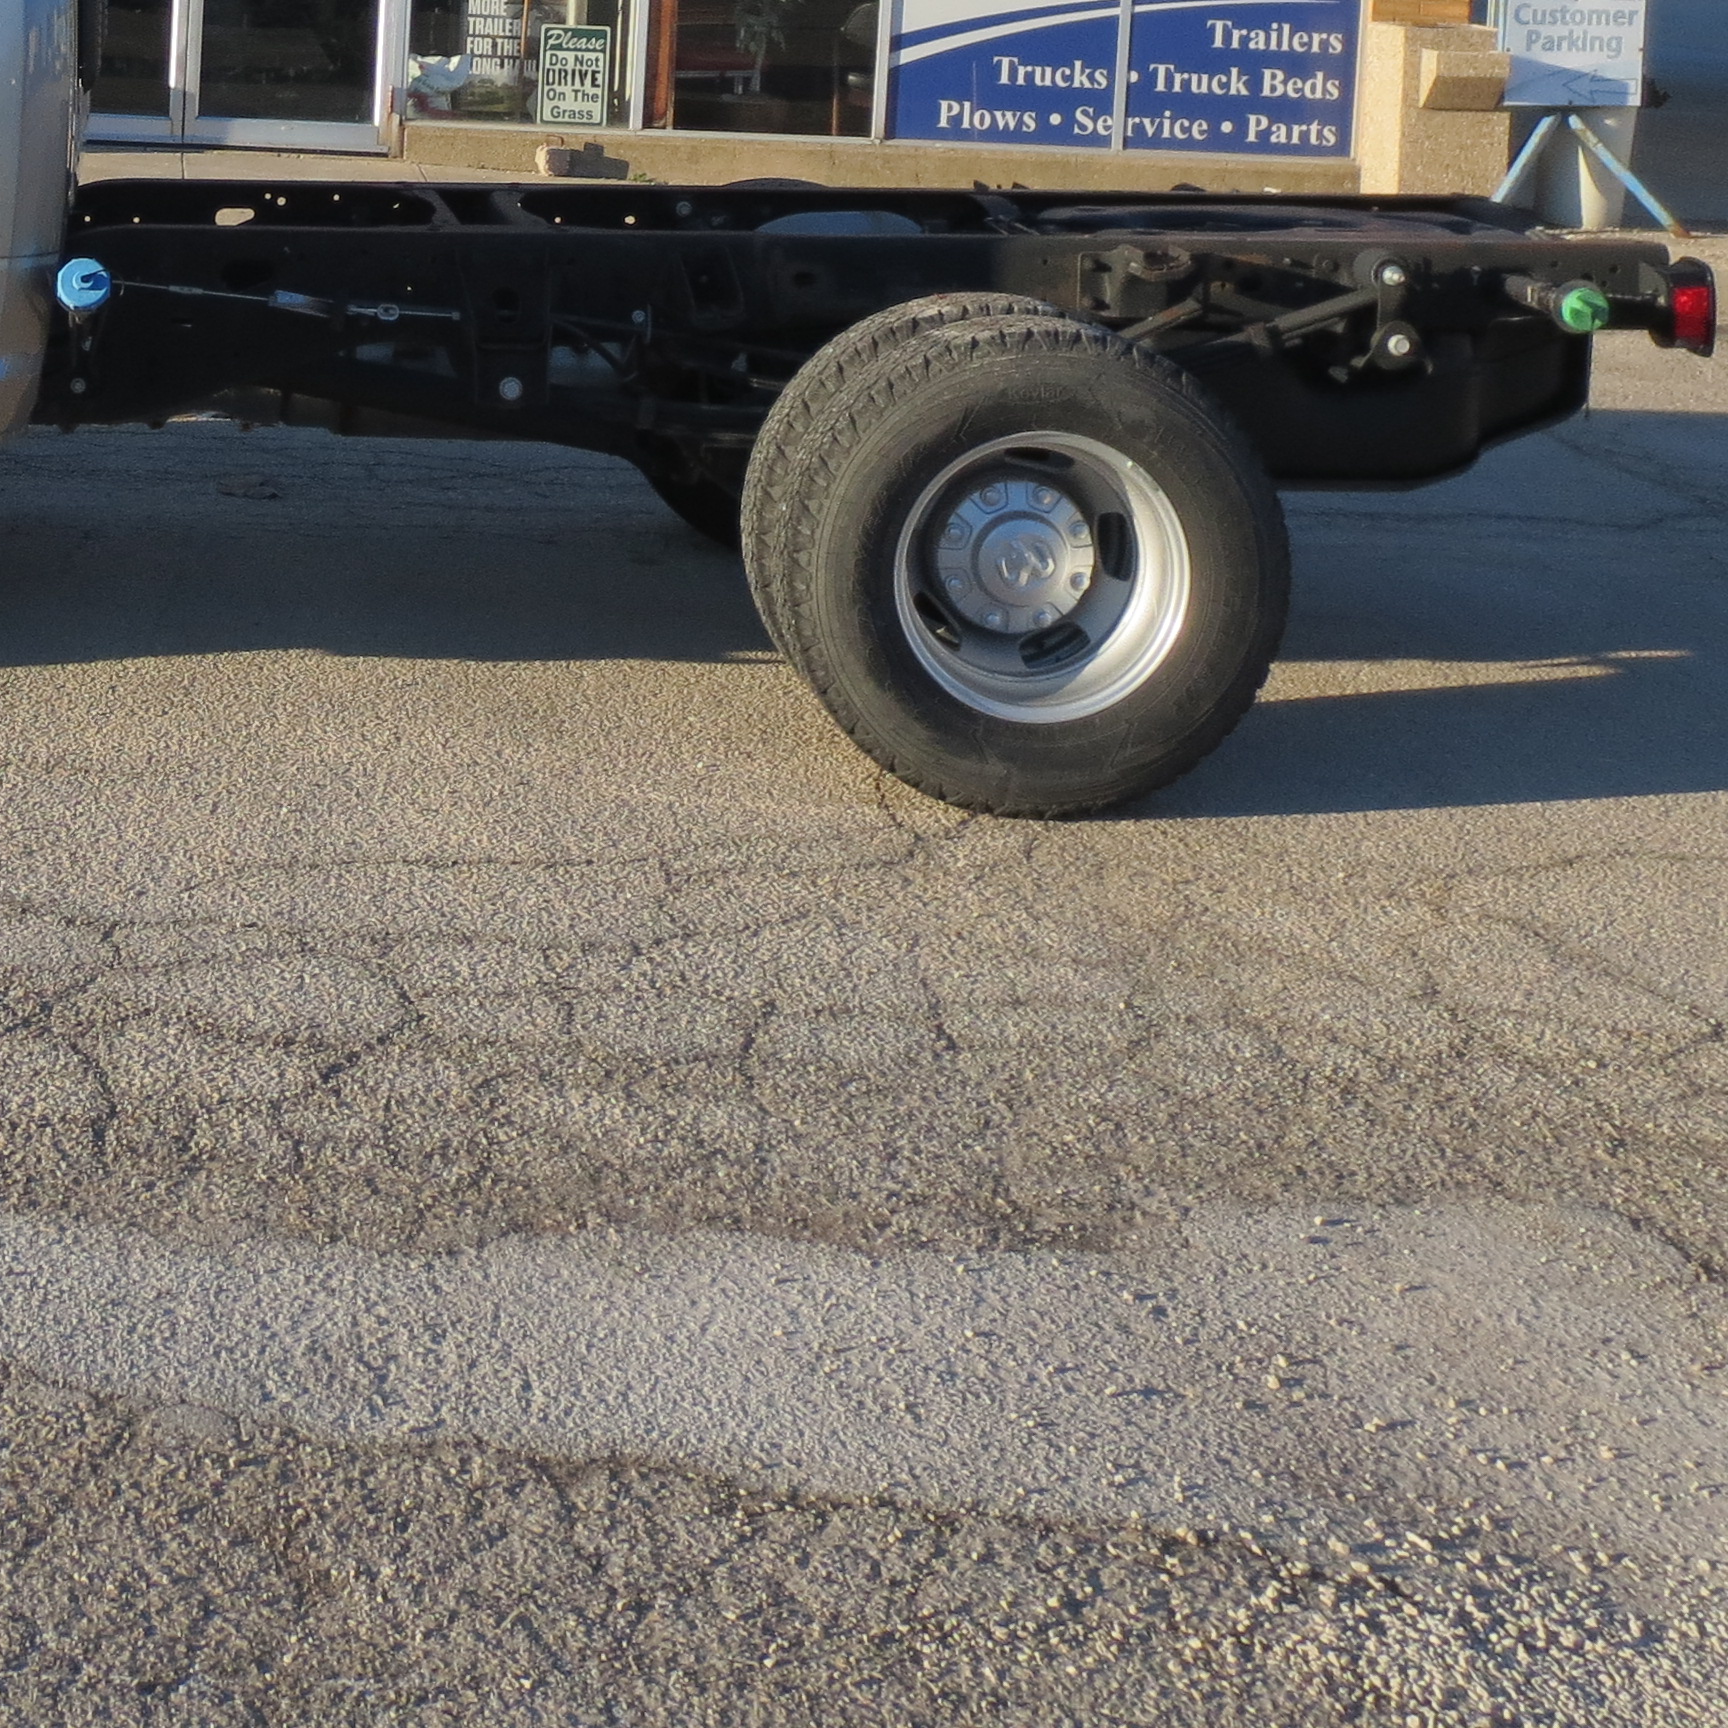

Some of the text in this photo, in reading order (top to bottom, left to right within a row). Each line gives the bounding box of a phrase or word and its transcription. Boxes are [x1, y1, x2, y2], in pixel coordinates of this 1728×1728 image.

[1514, 2, 1639, 25] Customer
[466, 37, 521, 56] FOR THE
[546, 29, 605, 50] Please
[1206, 20, 1343, 54] Trailers
[1525, 29, 1624, 59] Parking
[468, 56, 501, 74] ONG
[549, 53, 600, 68] Do Not
[546, 68, 601, 88] DRIVE
[993, 56, 1340, 101] Trucks Truck Beds
[547, 89, 599, 103] On The
[550, 106, 593, 120] Grass
[937, 100, 1337, 148] Plows Service Parts
